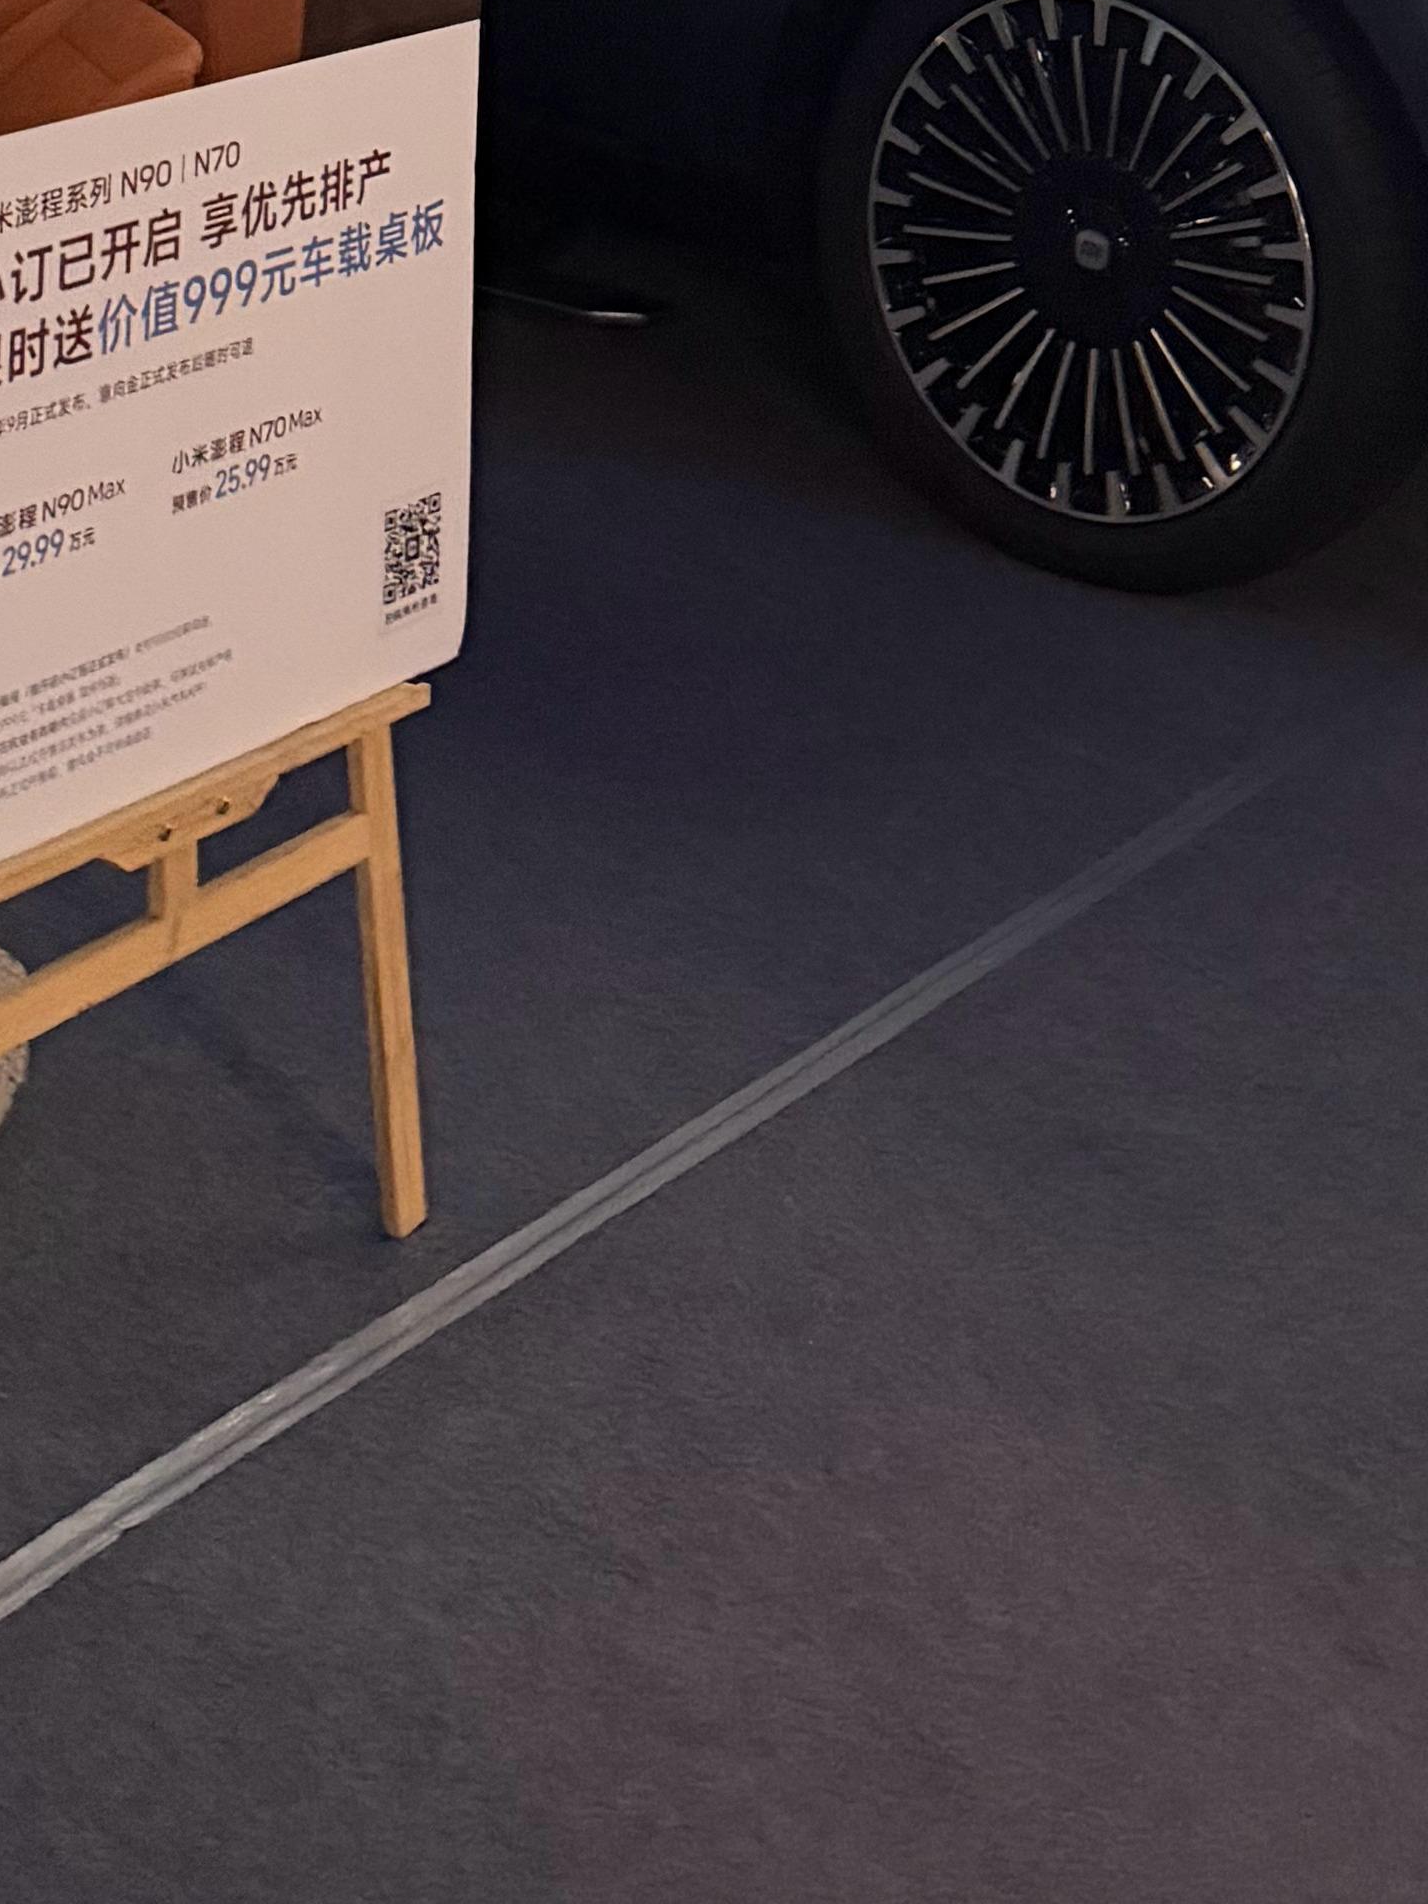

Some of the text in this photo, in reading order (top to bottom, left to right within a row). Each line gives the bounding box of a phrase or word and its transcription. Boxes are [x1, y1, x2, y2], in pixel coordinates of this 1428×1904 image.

[121, 160, 172, 197] N90
[194, 141, 242, 176] N70
[200, 148, 393, 250] 享优先排产
[172, 405, 322, 474] 小米澎程 N70 Max
[41, 489, 84, 524] N90
[86, 478, 126, 507] Max
[214, 453, 270, 499] 25.99
[1, 528, 64, 579] 29.99
